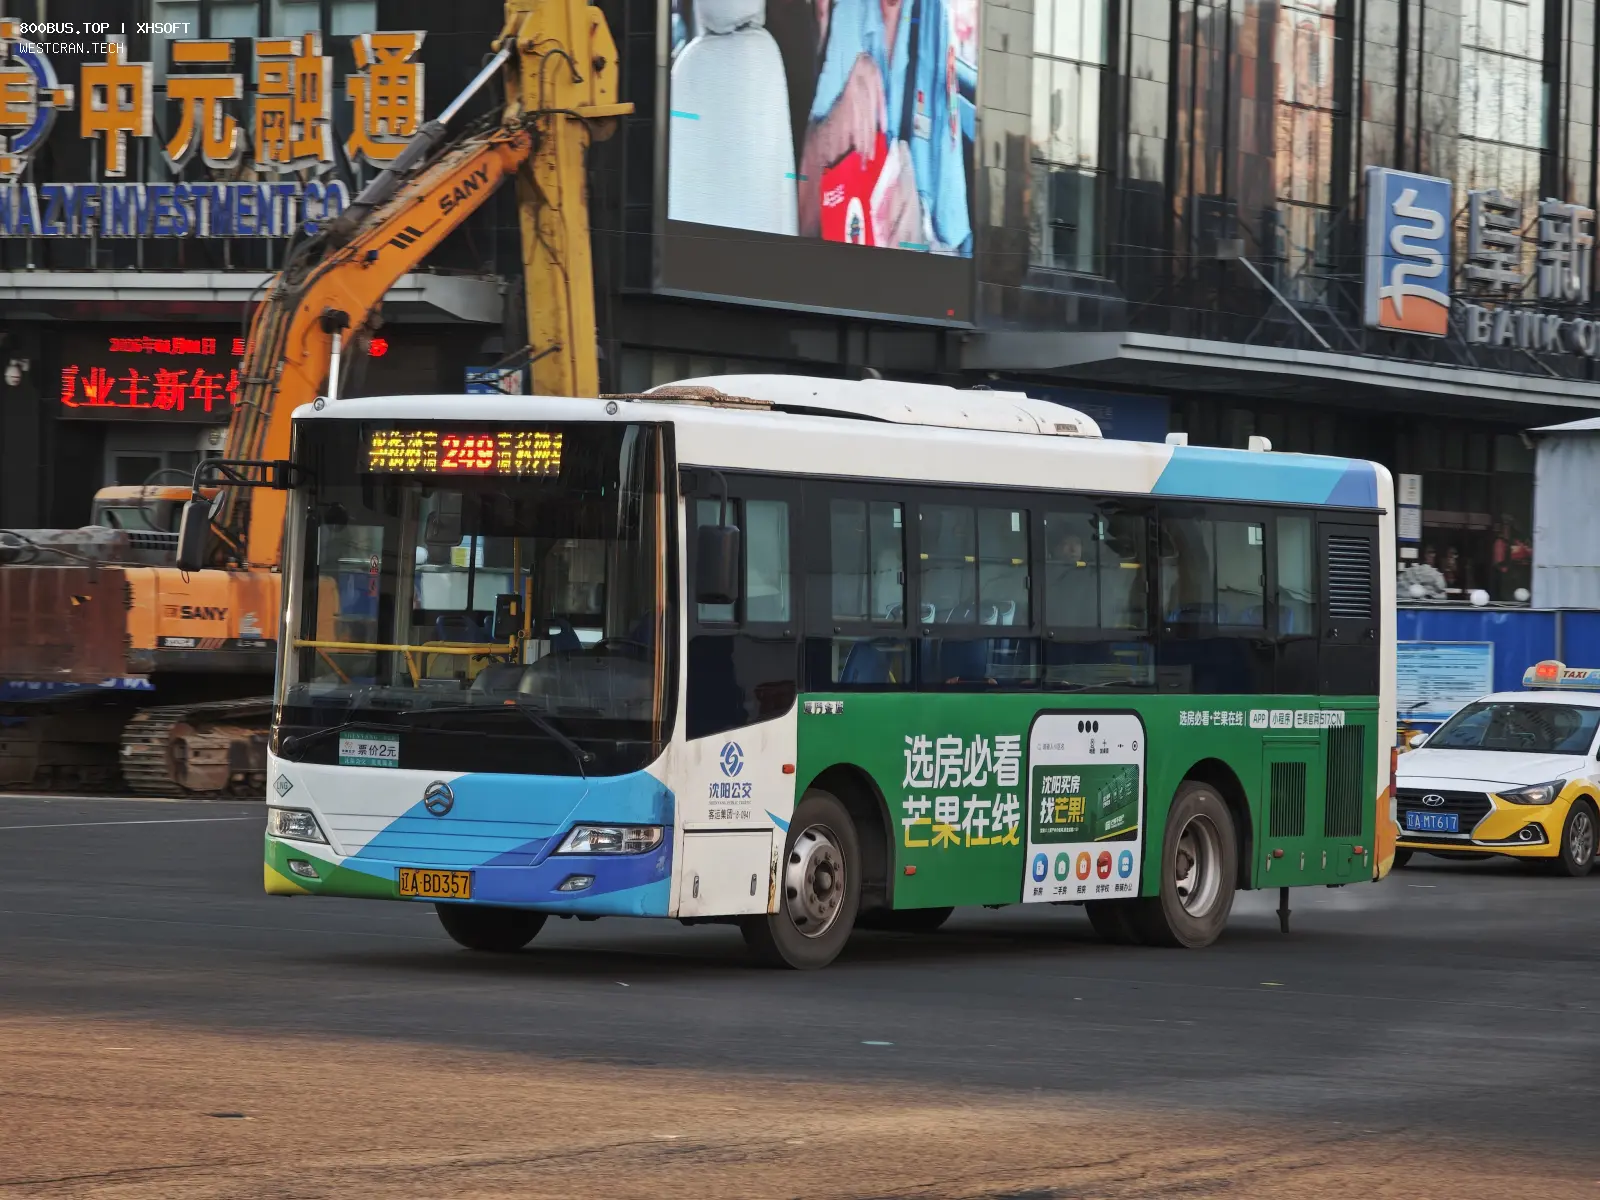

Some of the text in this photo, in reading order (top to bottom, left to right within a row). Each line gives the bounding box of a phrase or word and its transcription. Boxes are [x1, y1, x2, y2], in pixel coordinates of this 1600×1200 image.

[80, 30, 428, 178] 中元融通
[439, 163, 489, 216] SANY
[1465, 303, 1564, 356] BANK
[181, 605, 229, 620] SANY
[1563, 670, 1587, 679] TAXI
[1253, 713, 1266, 724] APP
[1272, 712, 1291, 725] 小程序
[357, 744, 397, 757] 票价2元
[902, 733, 1022, 789] 选房必看
[276, 781, 288, 790] LNG
[708, 782, 752, 799] 沈阳公交
[1041, 775, 1081, 795] 沈阳买房
[901, 793, 1021, 849] 芒果在线
